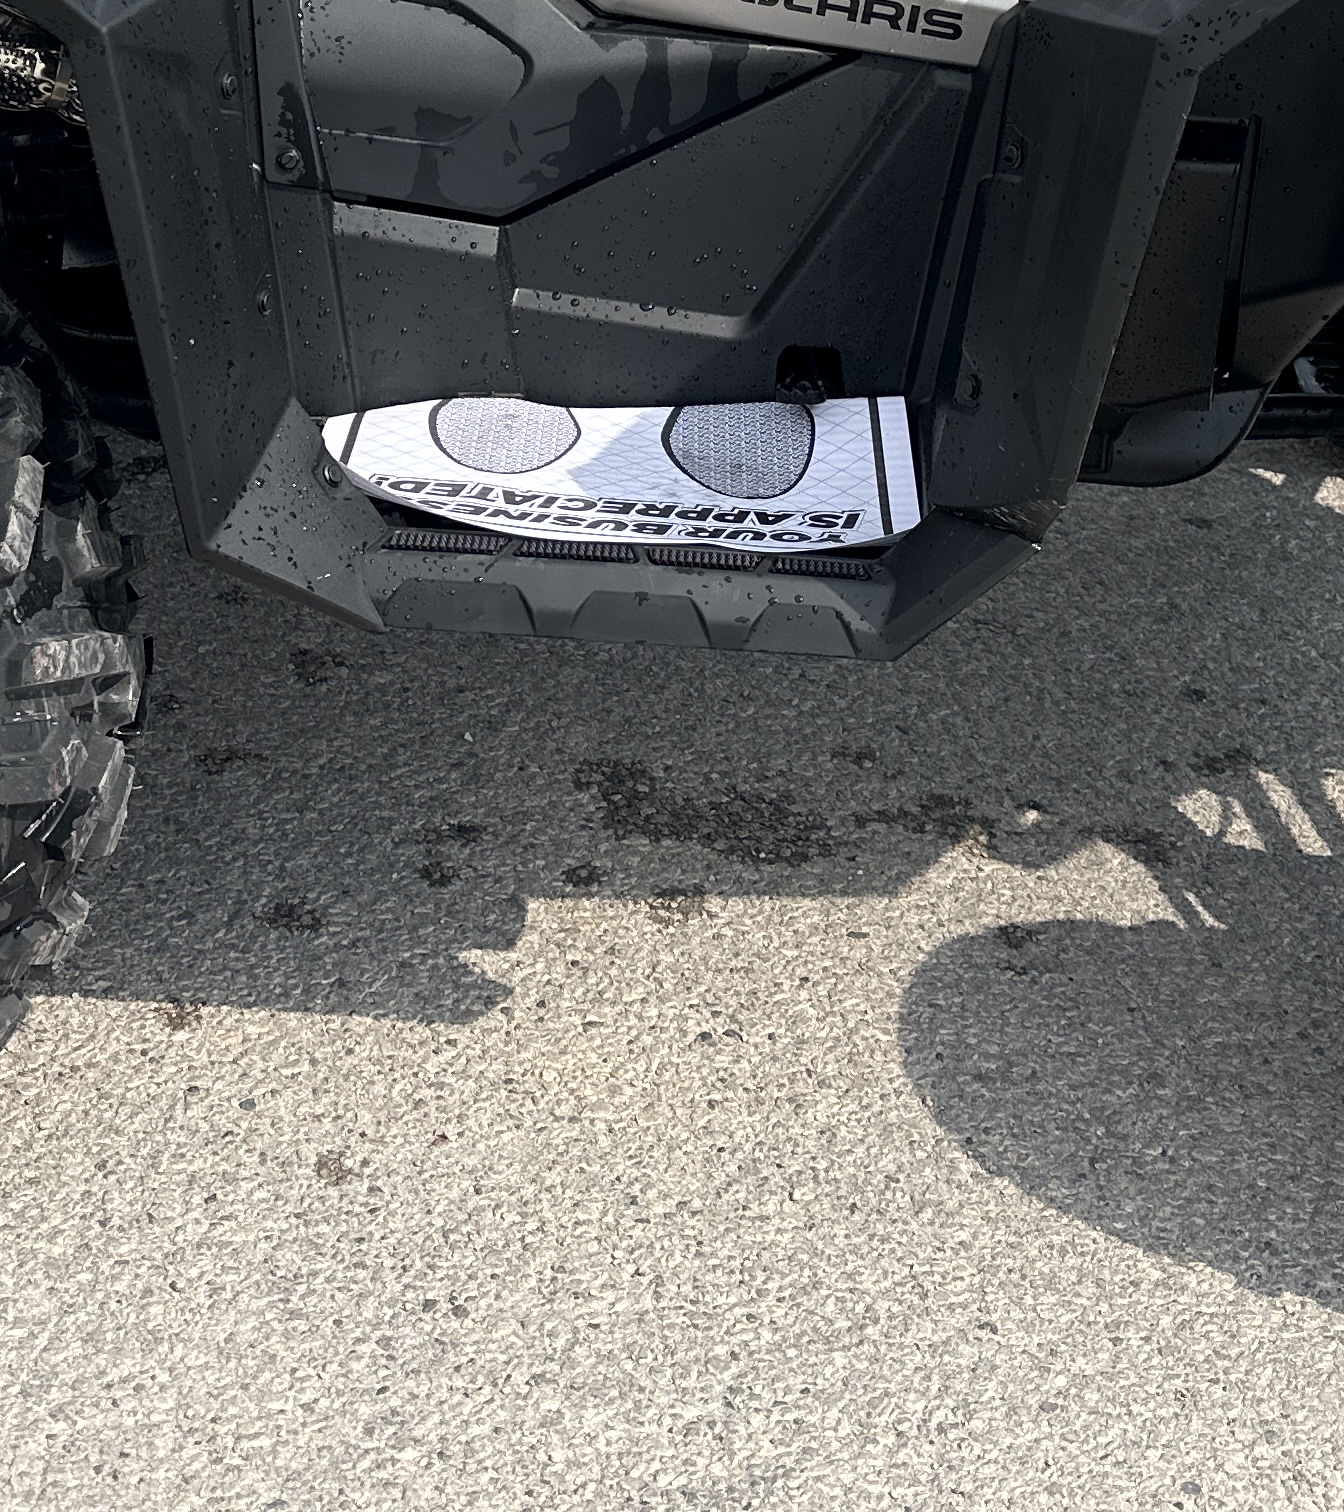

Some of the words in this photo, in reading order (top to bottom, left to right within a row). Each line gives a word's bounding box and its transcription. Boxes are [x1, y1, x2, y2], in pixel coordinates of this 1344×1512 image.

[368, 473, 796, 526] APPRECIATED!
[401, 495, 674, 537] BUSINES
[802, 511, 861, 530] IS
[679, 524, 846, 544] YOUR
